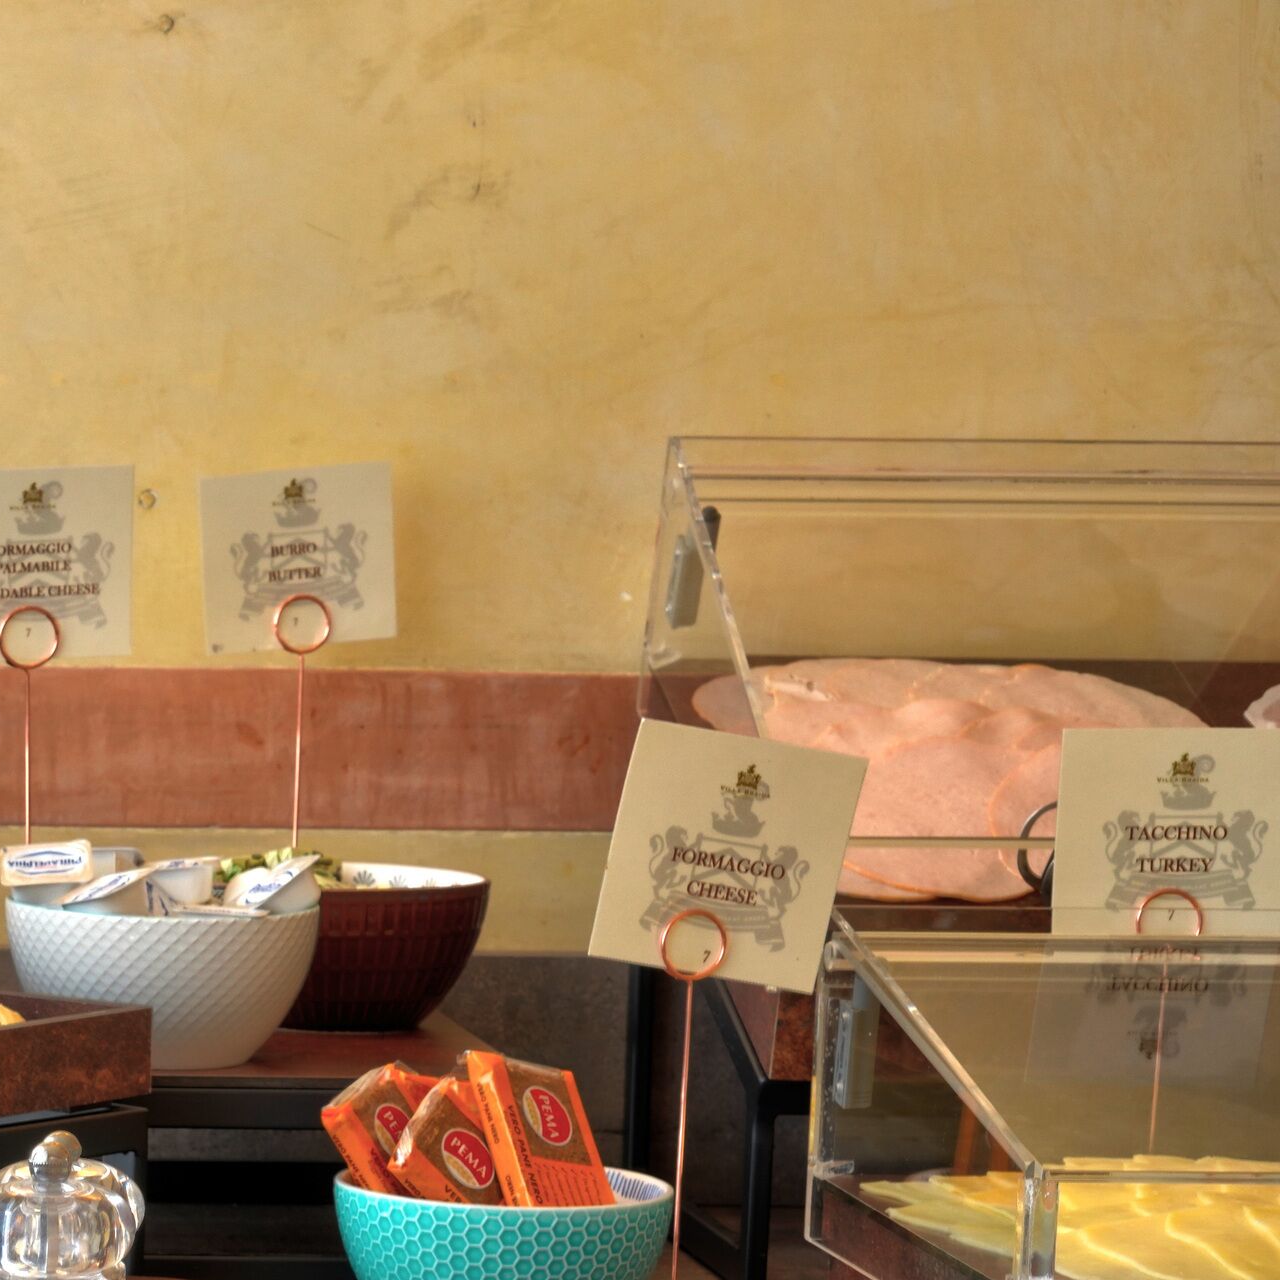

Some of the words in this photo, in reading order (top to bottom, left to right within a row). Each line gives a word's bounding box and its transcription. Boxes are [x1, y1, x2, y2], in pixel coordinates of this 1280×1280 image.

[271, 542, 317, 558] BURRO
[268, 566, 322, 582] BUTTER
[47, 583, 101, 597] CHEESE
[25, 627, 32, 638] 7
[1124, 824, 1228, 841] TACCHINO
[671, 846, 786, 880] FORMAGGIO
[1135, 856, 1214, 873] TURKEY
[686, 880, 758, 906] CHEESE
[1167, 908, 1176, 921] 7
[702, 950, 712, 963] 7
[538, 1094, 560, 1139] PEMA
[450, 1137, 488, 1179] PEMA
[507, 1105, 521, 1136] VERO
[518, 1138, 532, 1169] PANE
[528, 1172, 544, 1205] NERO
